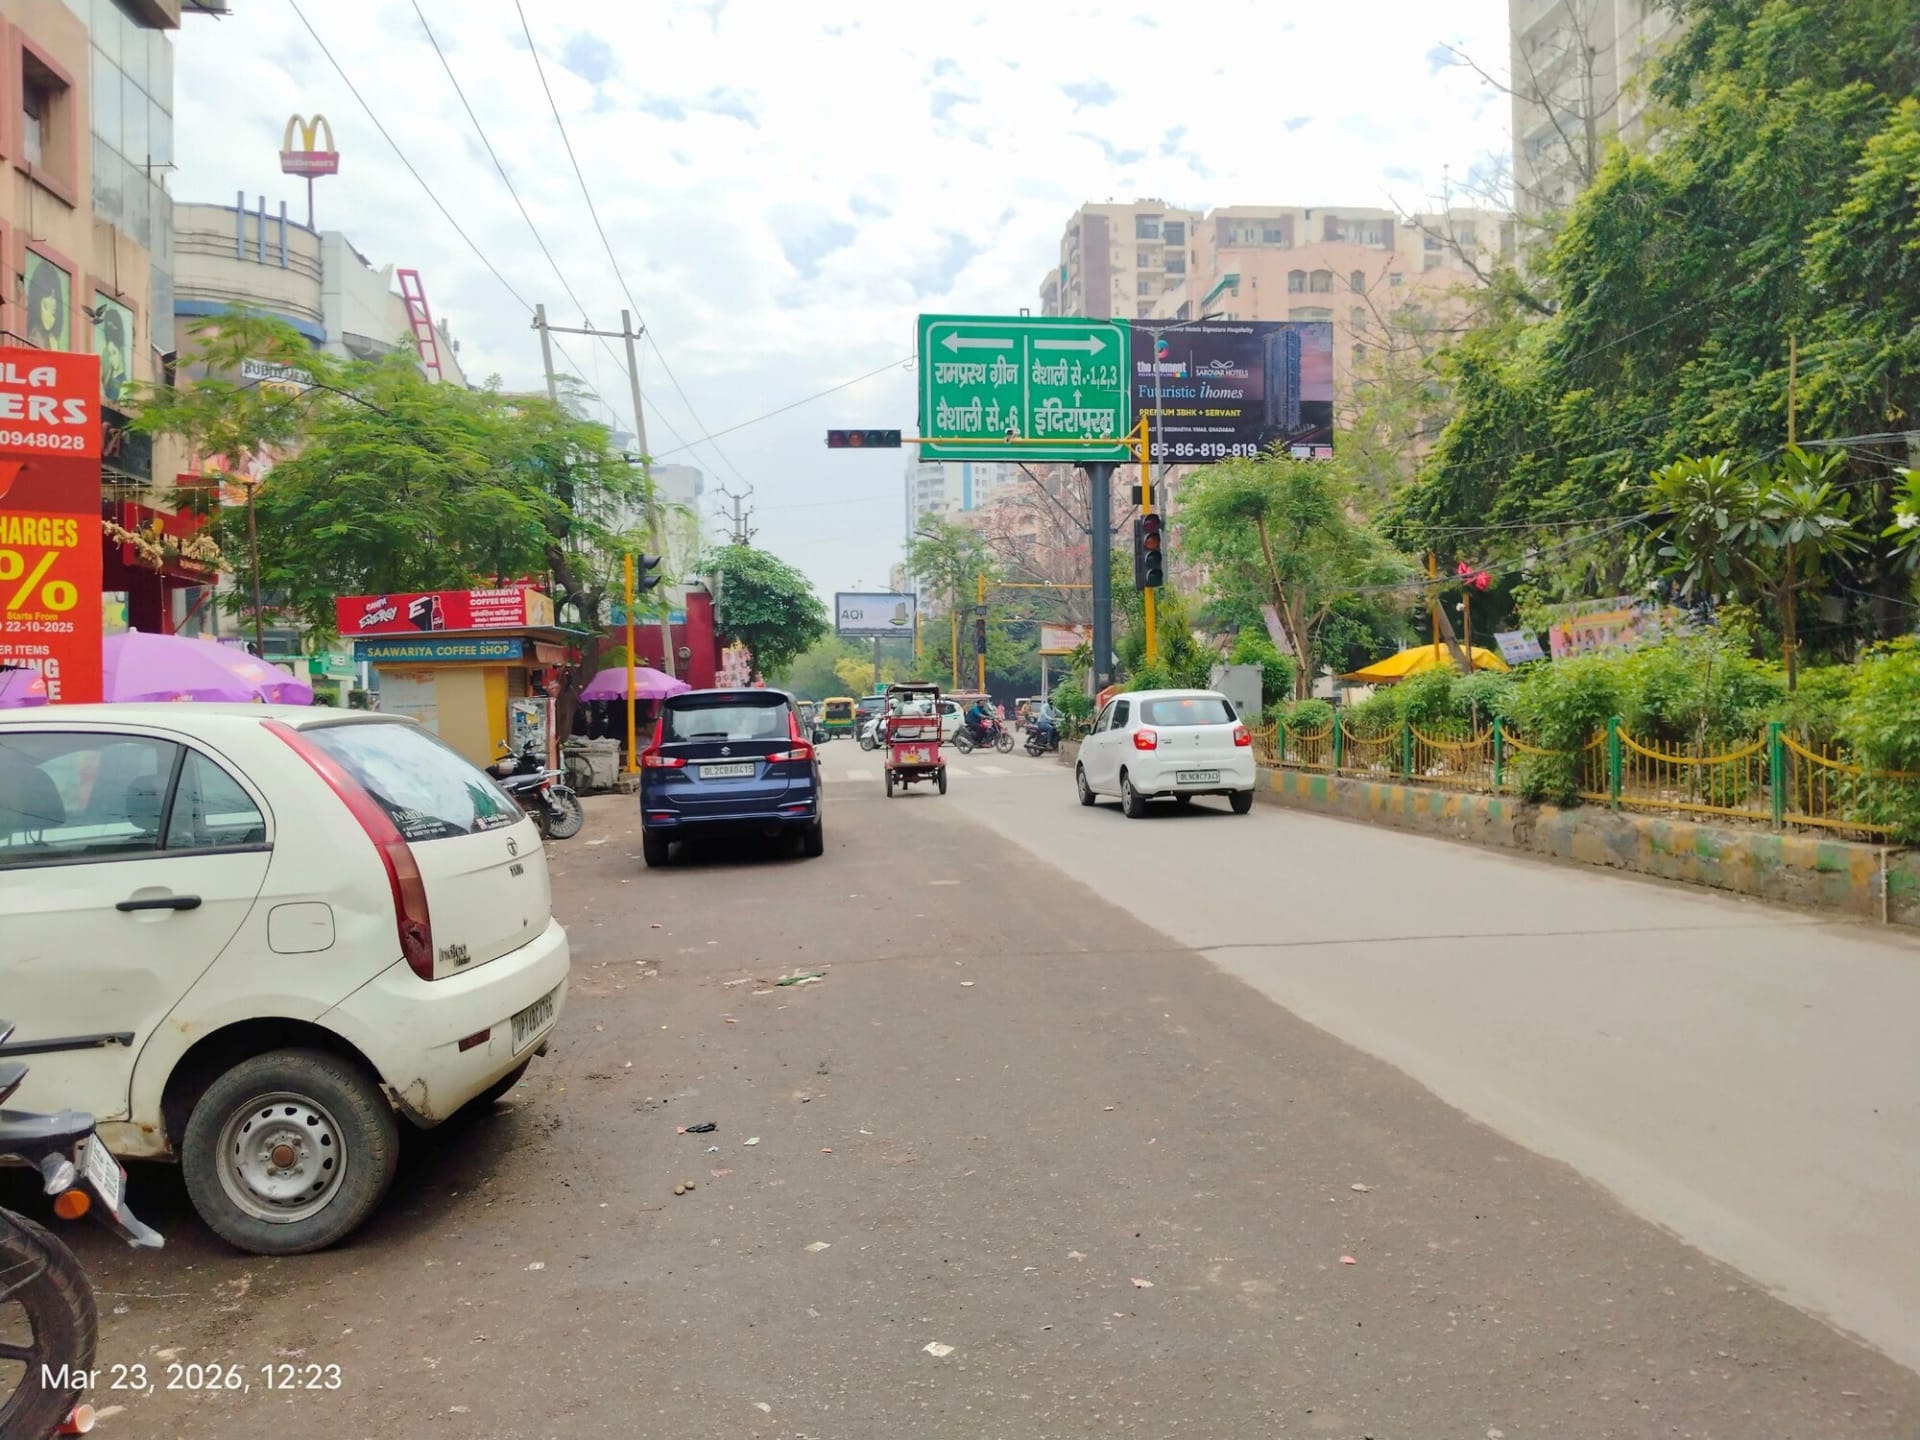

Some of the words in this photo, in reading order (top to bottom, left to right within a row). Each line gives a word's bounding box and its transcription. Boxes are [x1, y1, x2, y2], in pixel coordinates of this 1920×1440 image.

[1032, 358, 1069, 387] वैशाली
[1137, 361, 1152, 372] the
[1153, 361, 1186, 373] eement
[1226, 369, 1249, 377] HOTELS
[1138, 383, 1196, 398] Fuuristic
[936, 396, 983, 432] वैशाली
[1139, 408, 1175, 416] PREIUM
[1176, 408, 1197, 416] 3BHK
[1205, 409, 1242, 417] SERVANT
[470, 598, 499, 606] COFFEE
[35, 612, 58, 621] From
[358, 606, 398, 629] ENERGY
[6, 621, 74, 633] 22-10-2025
[15, 645, 50, 655] ITEMS
[367, 646, 433, 658] SAAWARIYA
[436, 645, 477, 657] COFFEE
[479, 644, 510, 656] SHOP
